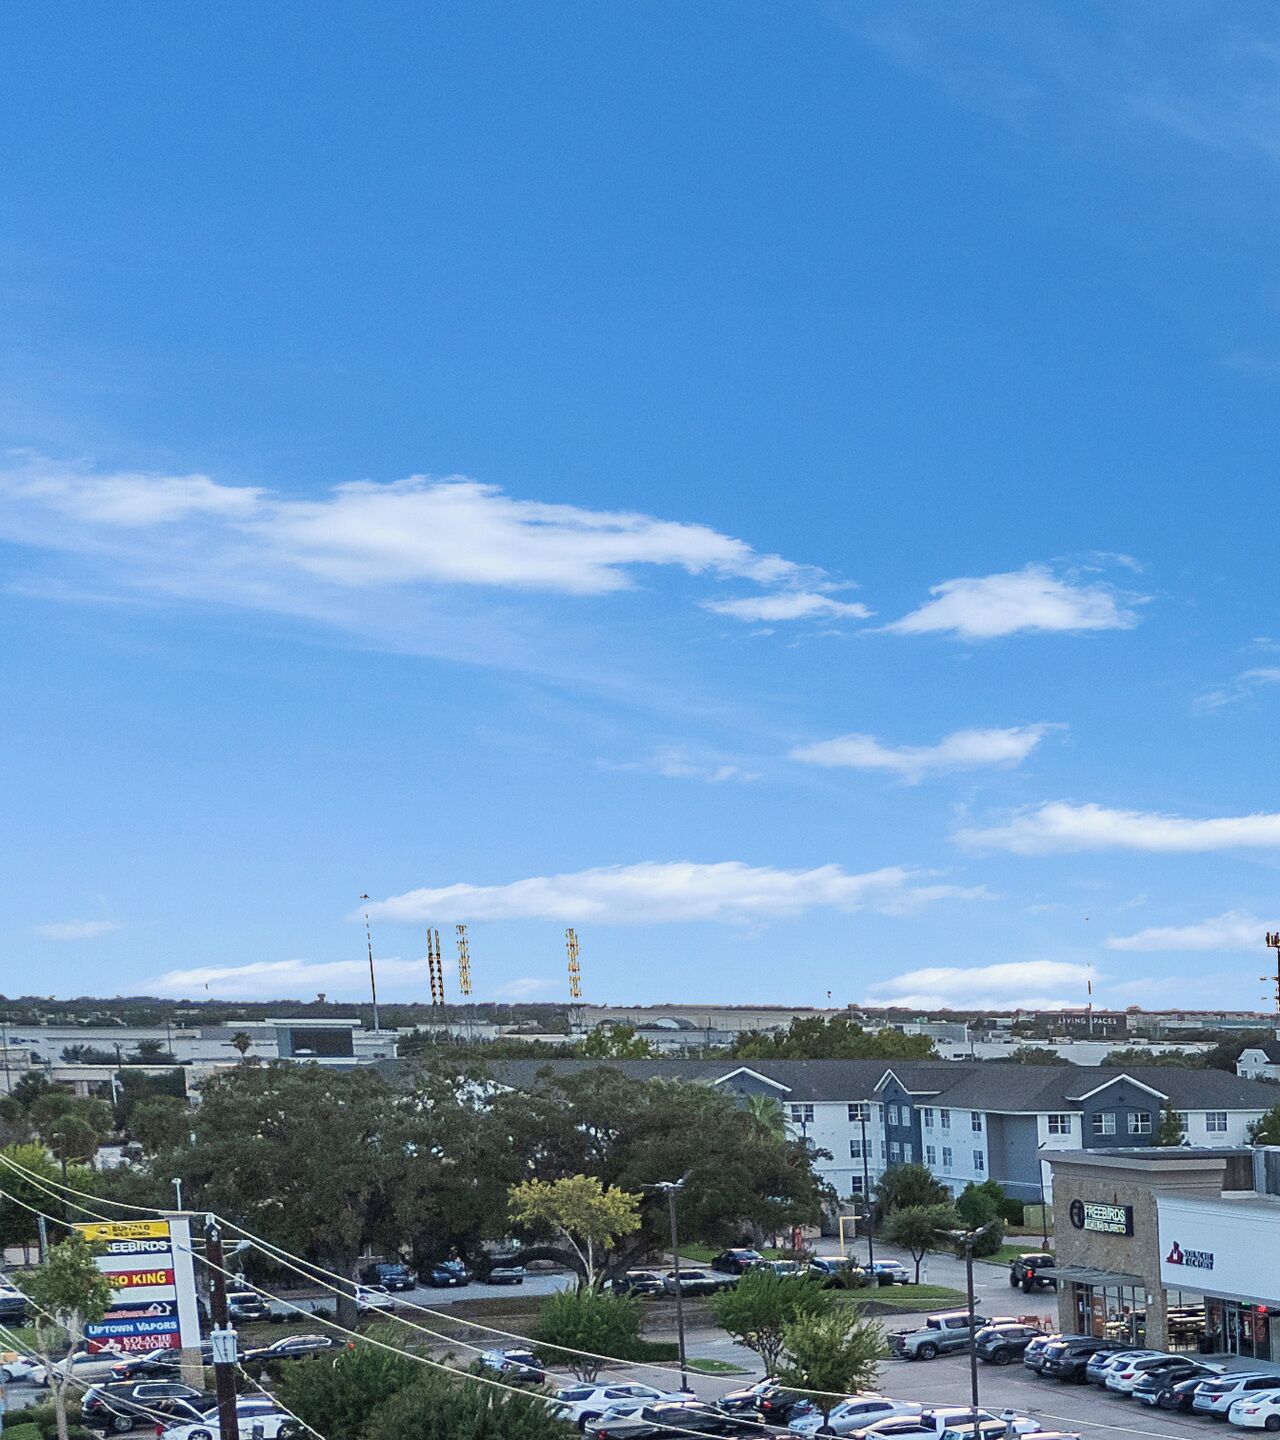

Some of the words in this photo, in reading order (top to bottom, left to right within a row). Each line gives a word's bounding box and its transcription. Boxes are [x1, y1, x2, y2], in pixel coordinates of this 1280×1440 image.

[1058, 1017, 1087, 1025] LIVING
[1084, 1205, 1126, 1222] FREEBIRDS
[108, 1241, 168, 1253] EEBIRDS
[132, 1271, 167, 1285] KING
[88, 1324, 134, 1335] UPTOWN
[136, 1321, 178, 1332] VAPORS
